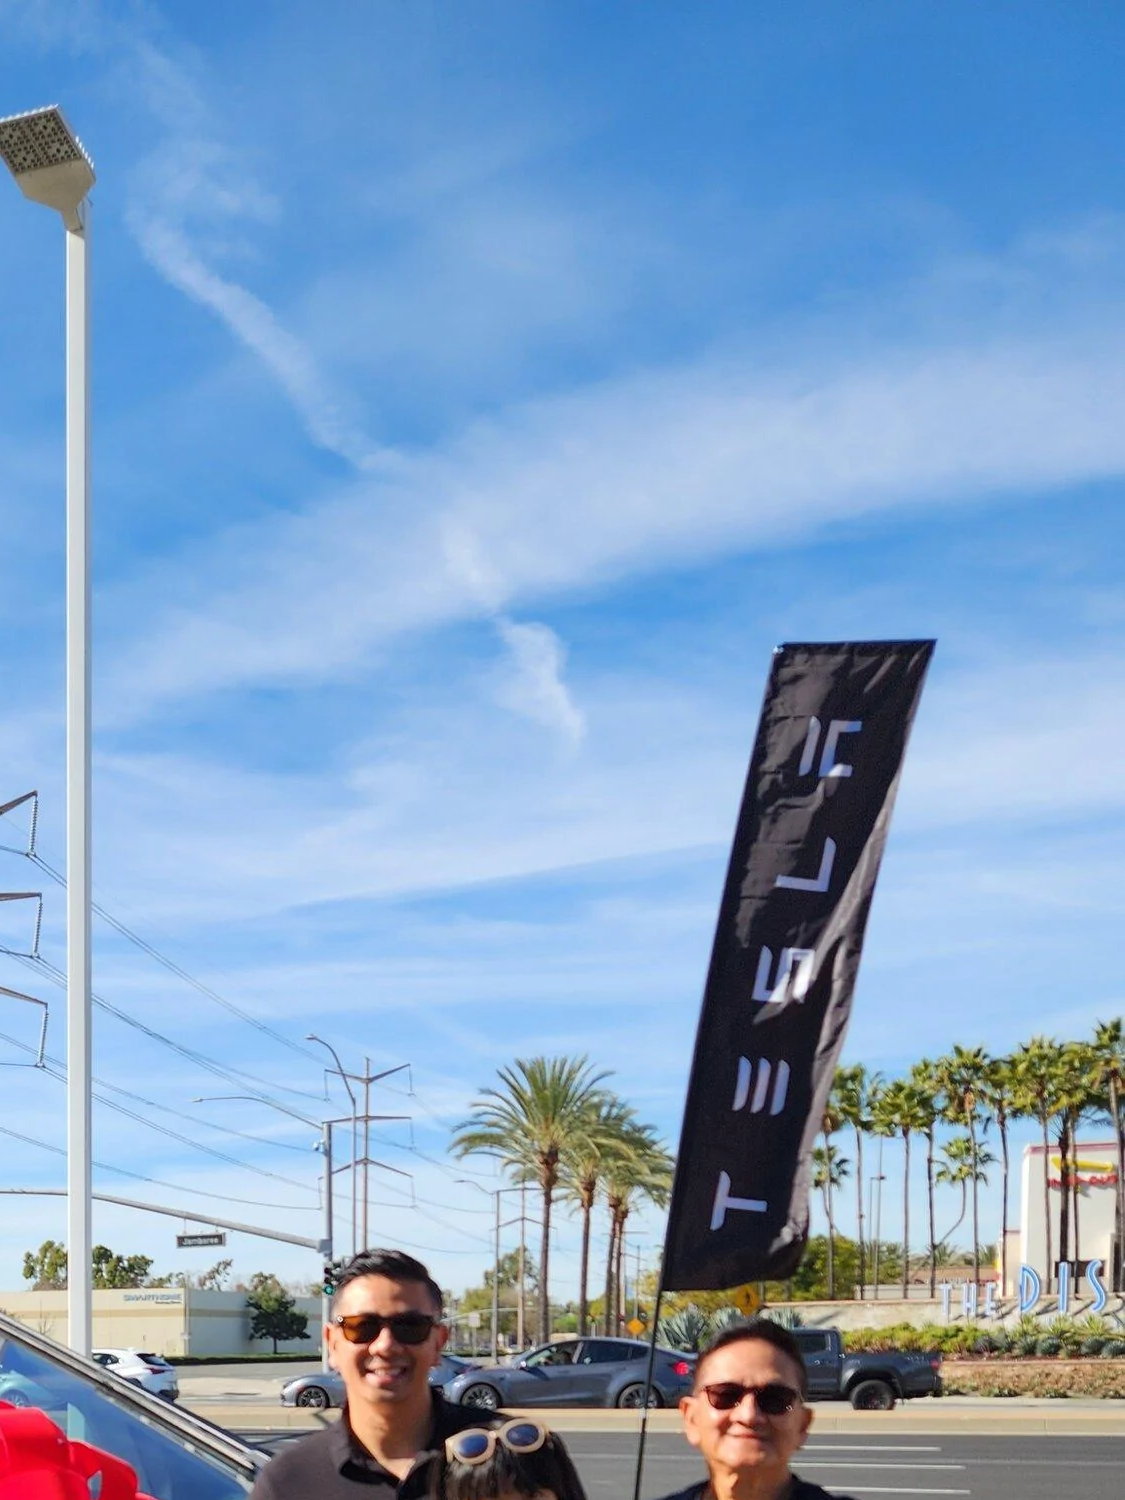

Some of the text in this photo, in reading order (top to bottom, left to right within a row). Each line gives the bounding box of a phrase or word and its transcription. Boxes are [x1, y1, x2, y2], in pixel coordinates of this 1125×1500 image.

[710, 715, 863, 1232] TESLA
[939, 1258, 1107, 1317] THE DIS
